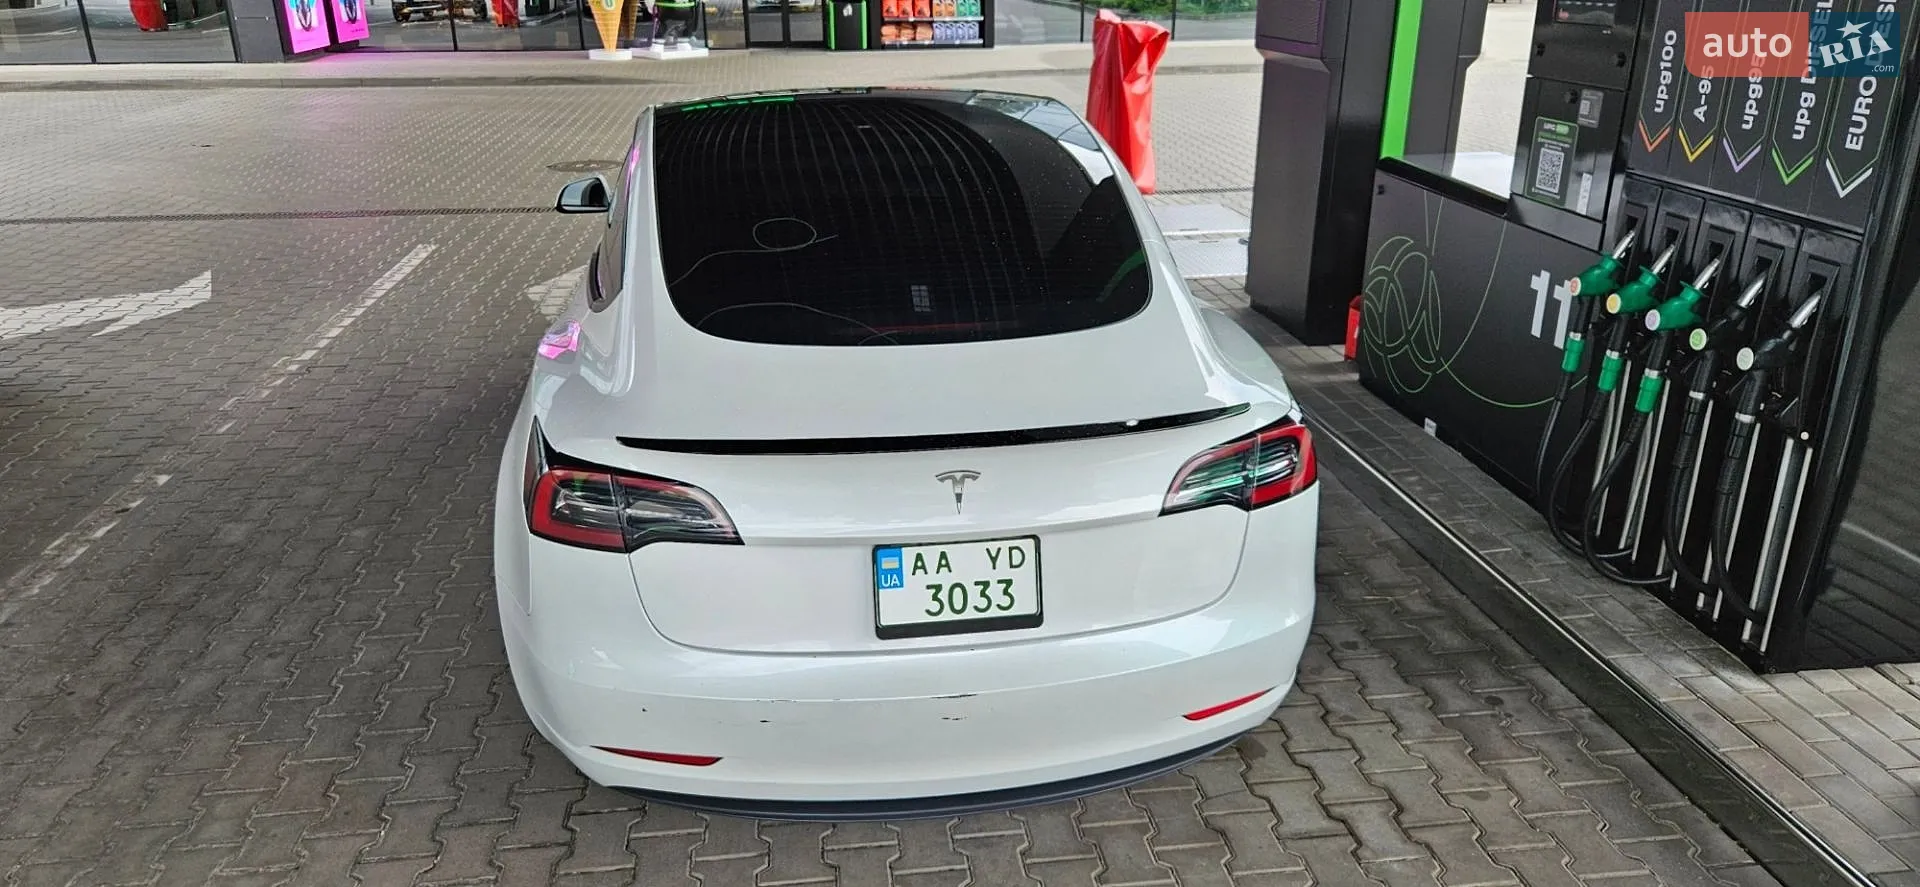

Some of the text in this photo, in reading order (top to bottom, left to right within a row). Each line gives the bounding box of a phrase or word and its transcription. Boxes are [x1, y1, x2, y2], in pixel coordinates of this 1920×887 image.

[1654, 30, 1677, 113] upg100
[1693, 65, 1714, 123] A-95
[1742, 53, 1765, 130] upg95
[1792, 92, 1816, 140] upg
[1845, 76, 1877, 151] EURO
[1530, 269, 1573, 350] 11
[881, 574, 900, 588] UA
[912, 546, 1026, 576] AA YD
[925, 578, 1015, 617] 3033
